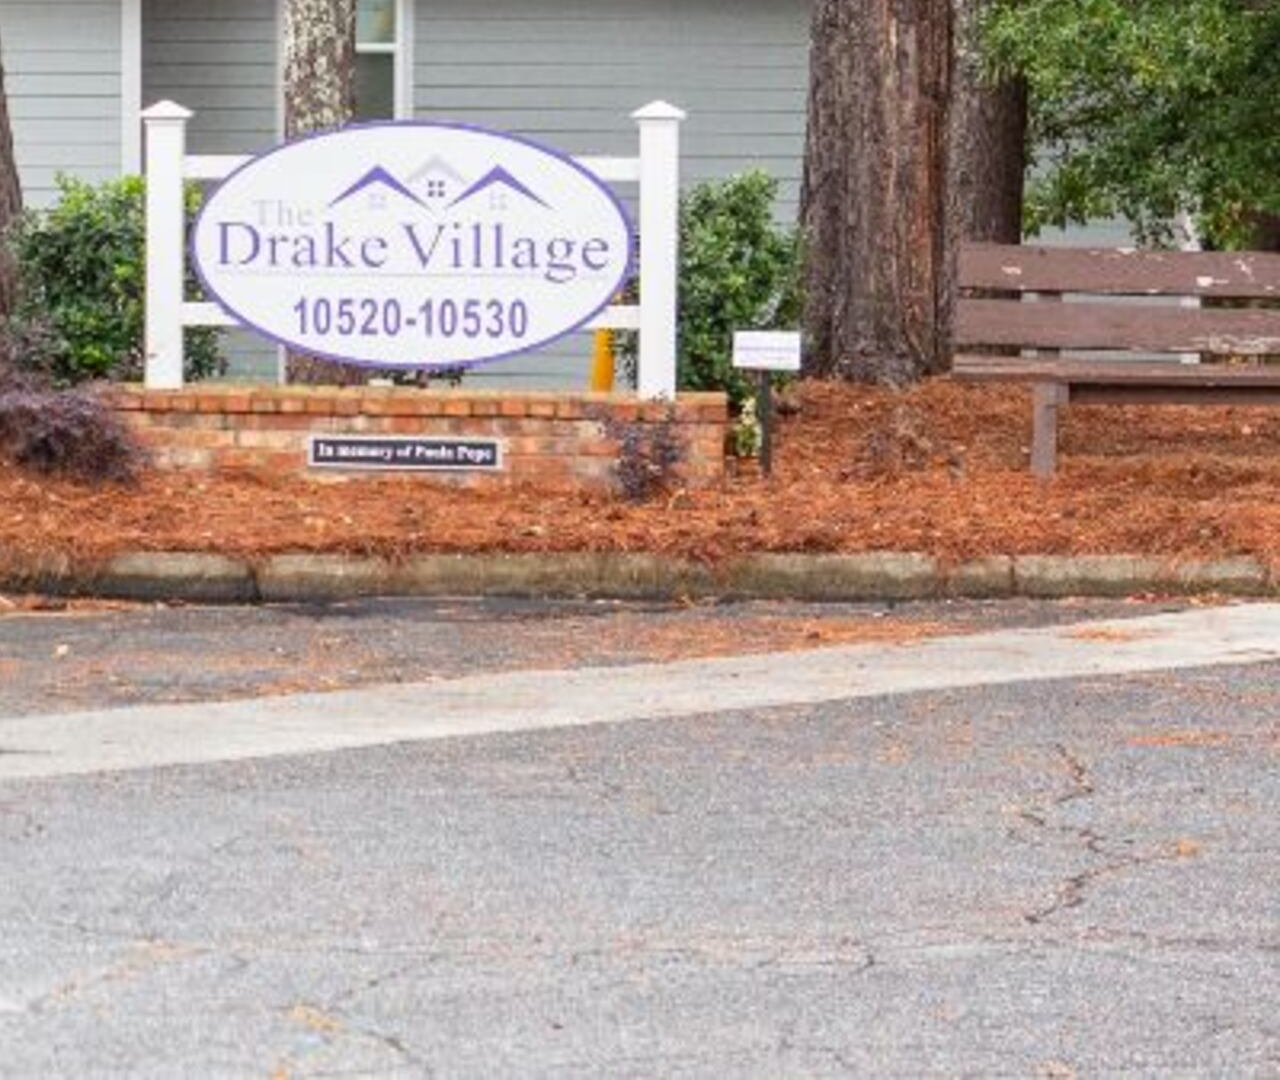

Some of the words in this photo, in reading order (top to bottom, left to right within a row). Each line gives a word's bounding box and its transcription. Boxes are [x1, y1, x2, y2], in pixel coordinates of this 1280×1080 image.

[251, 198, 314, 227] The
[217, 221, 389, 269] Drake
[402, 222, 610, 284] Village
[293, 295, 529, 339] 10520-10530
[318, 442, 334, 457] In
[396, 445, 412, 458] of
